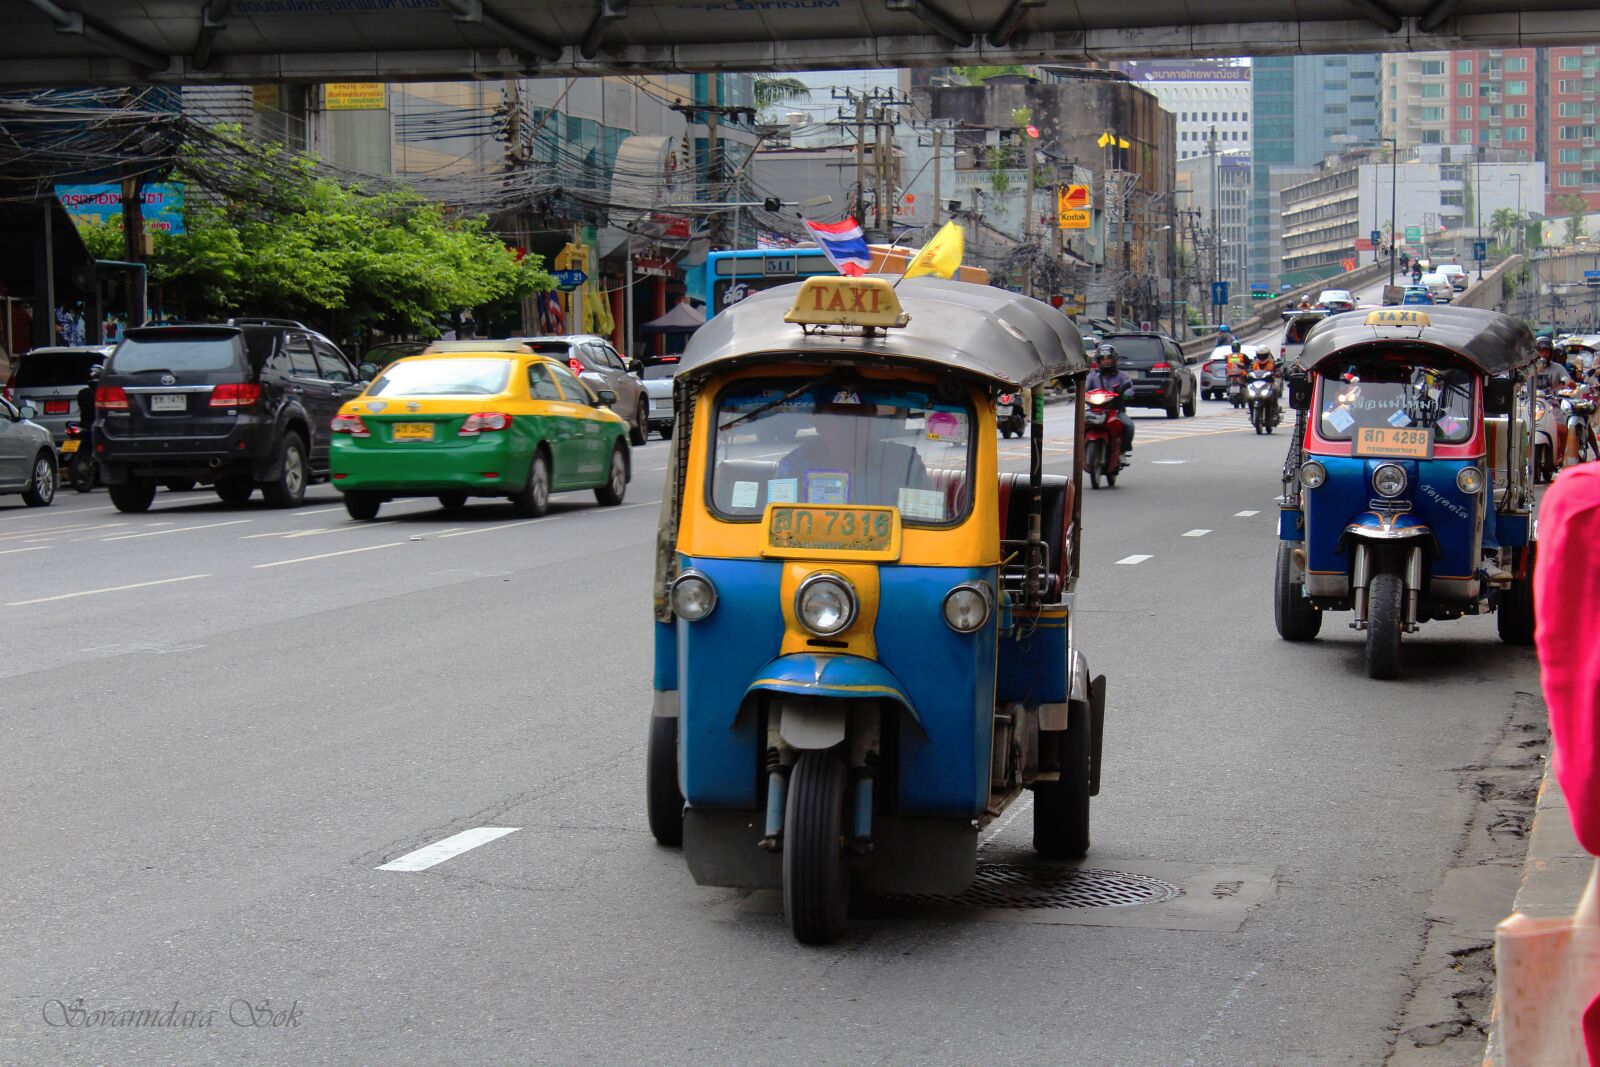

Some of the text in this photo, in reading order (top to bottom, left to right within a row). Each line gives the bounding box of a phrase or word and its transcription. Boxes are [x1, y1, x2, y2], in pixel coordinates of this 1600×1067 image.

[1061, 213, 1086, 221] Kodak
[767, 260, 791, 272] 511
[573, 273, 582, 281] 21
[809, 286, 882, 314] TAXI
[1378, 311, 1418, 322] TAXI
[1392, 431, 1427, 445] 4268
[823, 511, 890, 538] 7316
